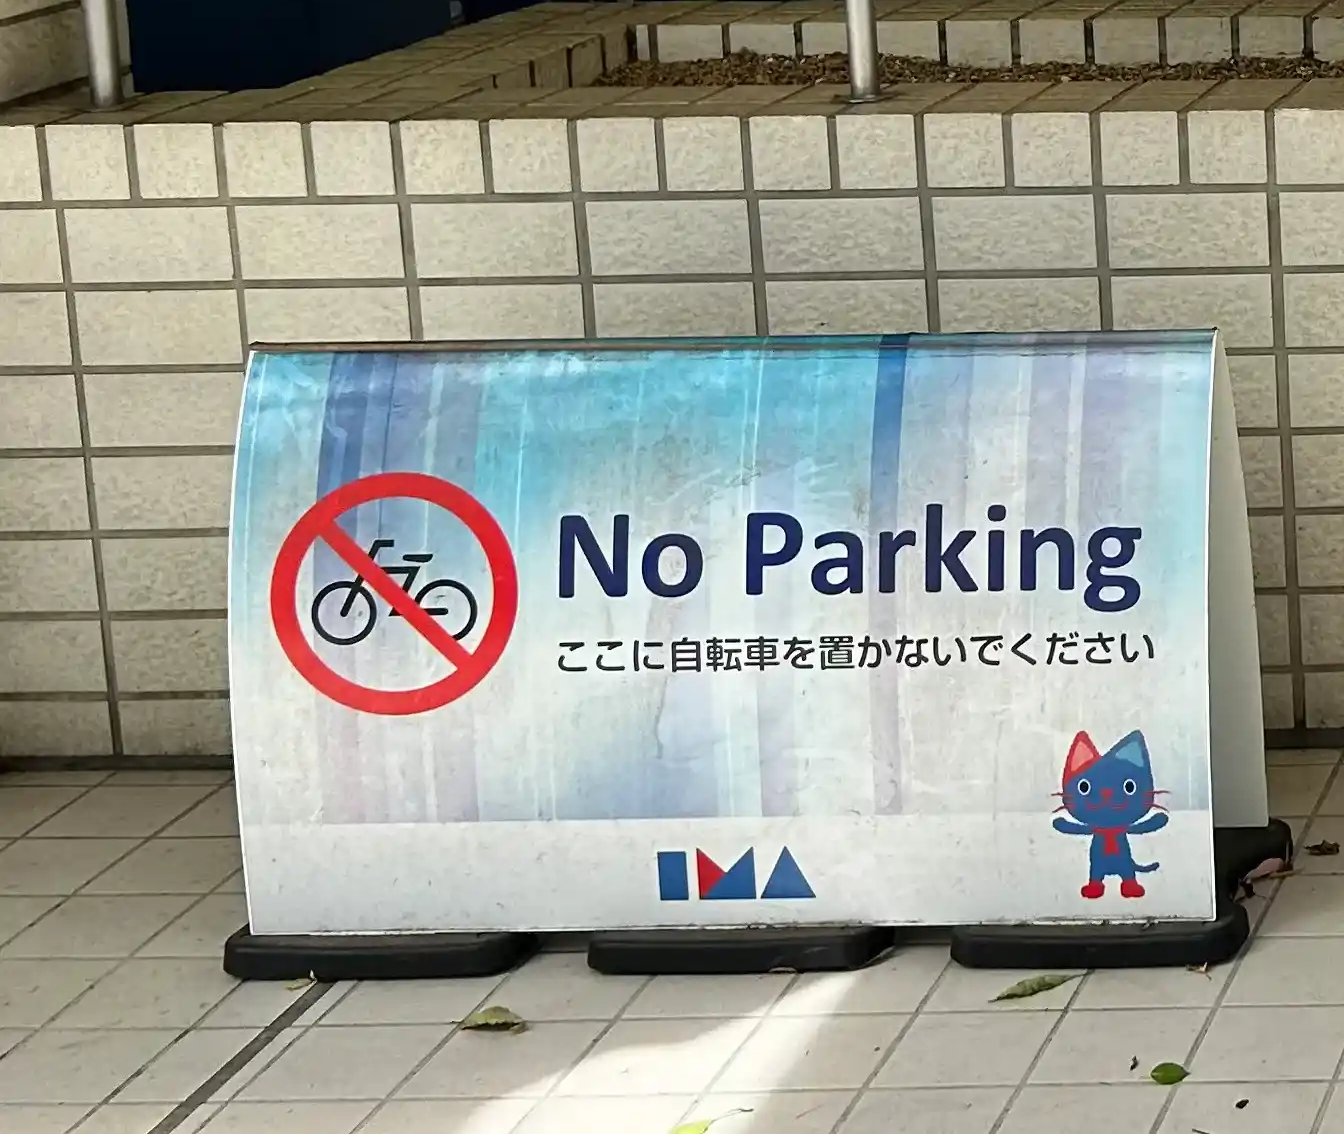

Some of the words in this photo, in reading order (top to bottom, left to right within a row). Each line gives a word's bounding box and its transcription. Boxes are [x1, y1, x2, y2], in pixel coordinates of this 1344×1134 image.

[558, 512, 704, 600] No
[744, 503, 1143, 614] Parking
[557, 633, 1156, 675] ここに自転車を置かないでください
[657, 846, 817, 901] IMA
